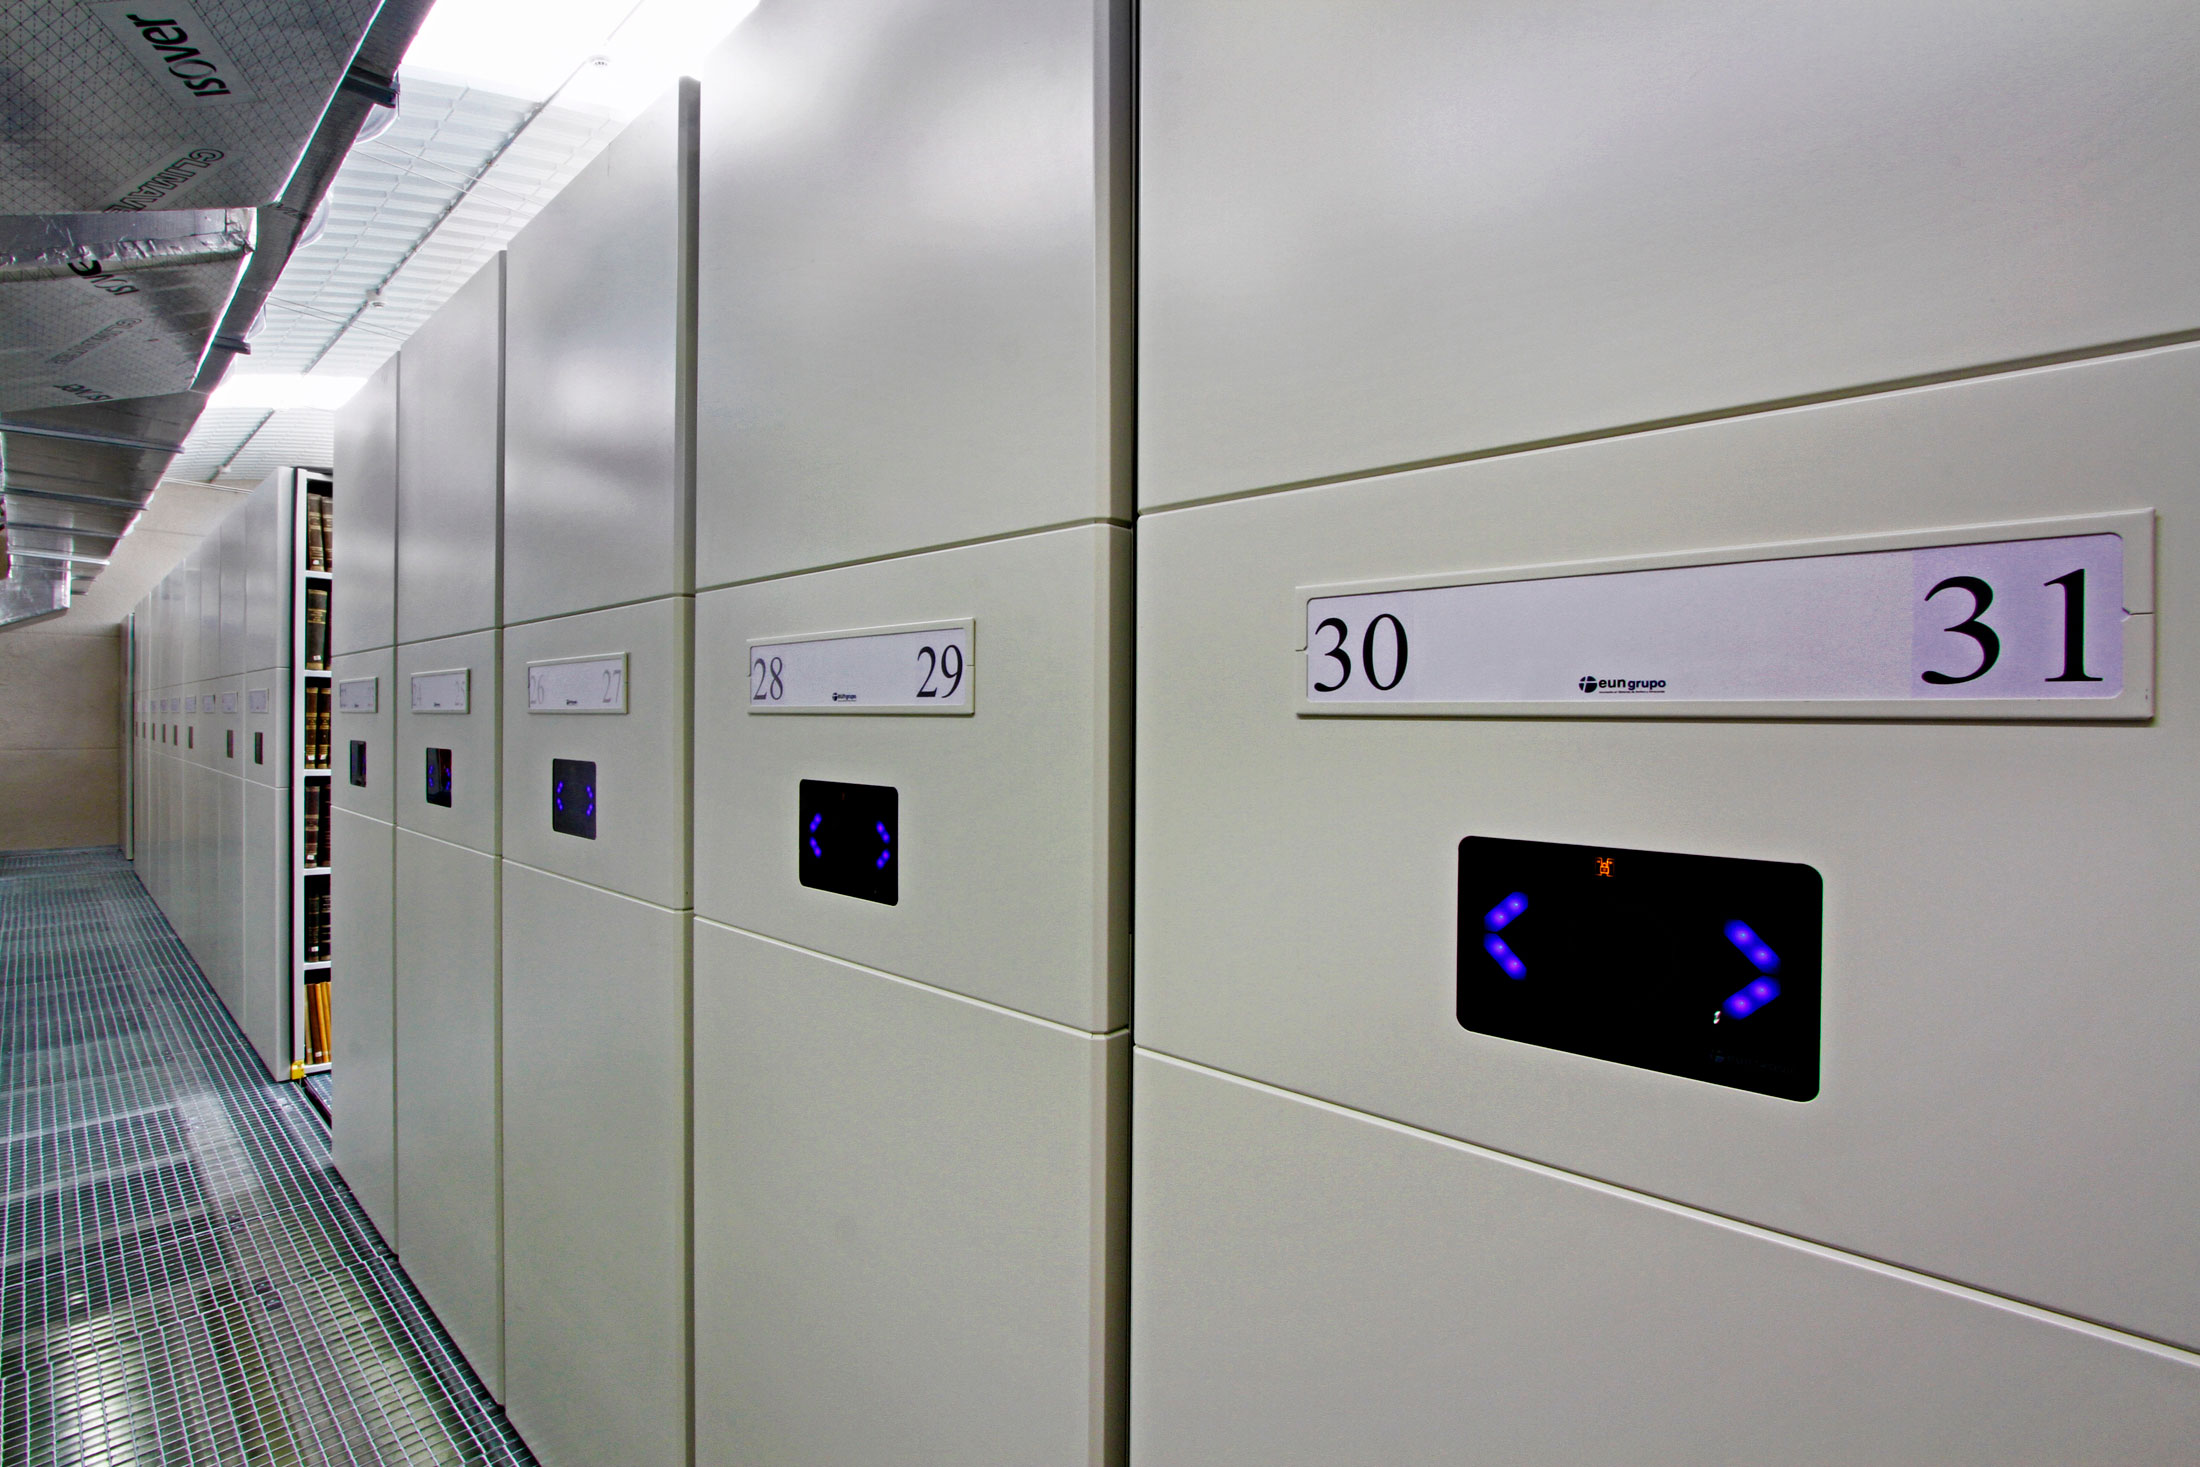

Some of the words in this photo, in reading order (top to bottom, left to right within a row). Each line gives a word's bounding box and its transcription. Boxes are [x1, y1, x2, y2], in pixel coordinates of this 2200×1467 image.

[1313, 613, 1408, 692] 30
[1922, 568, 2104, 685] 31
[530, 674, 545, 705] 26
[602, 669, 622, 703] 27
[752, 656, 784, 700] 28
[916, 644, 963, 699] 29
[1598, 678, 1626, 689] eun
[1627, 679, 1667, 691] grupo
